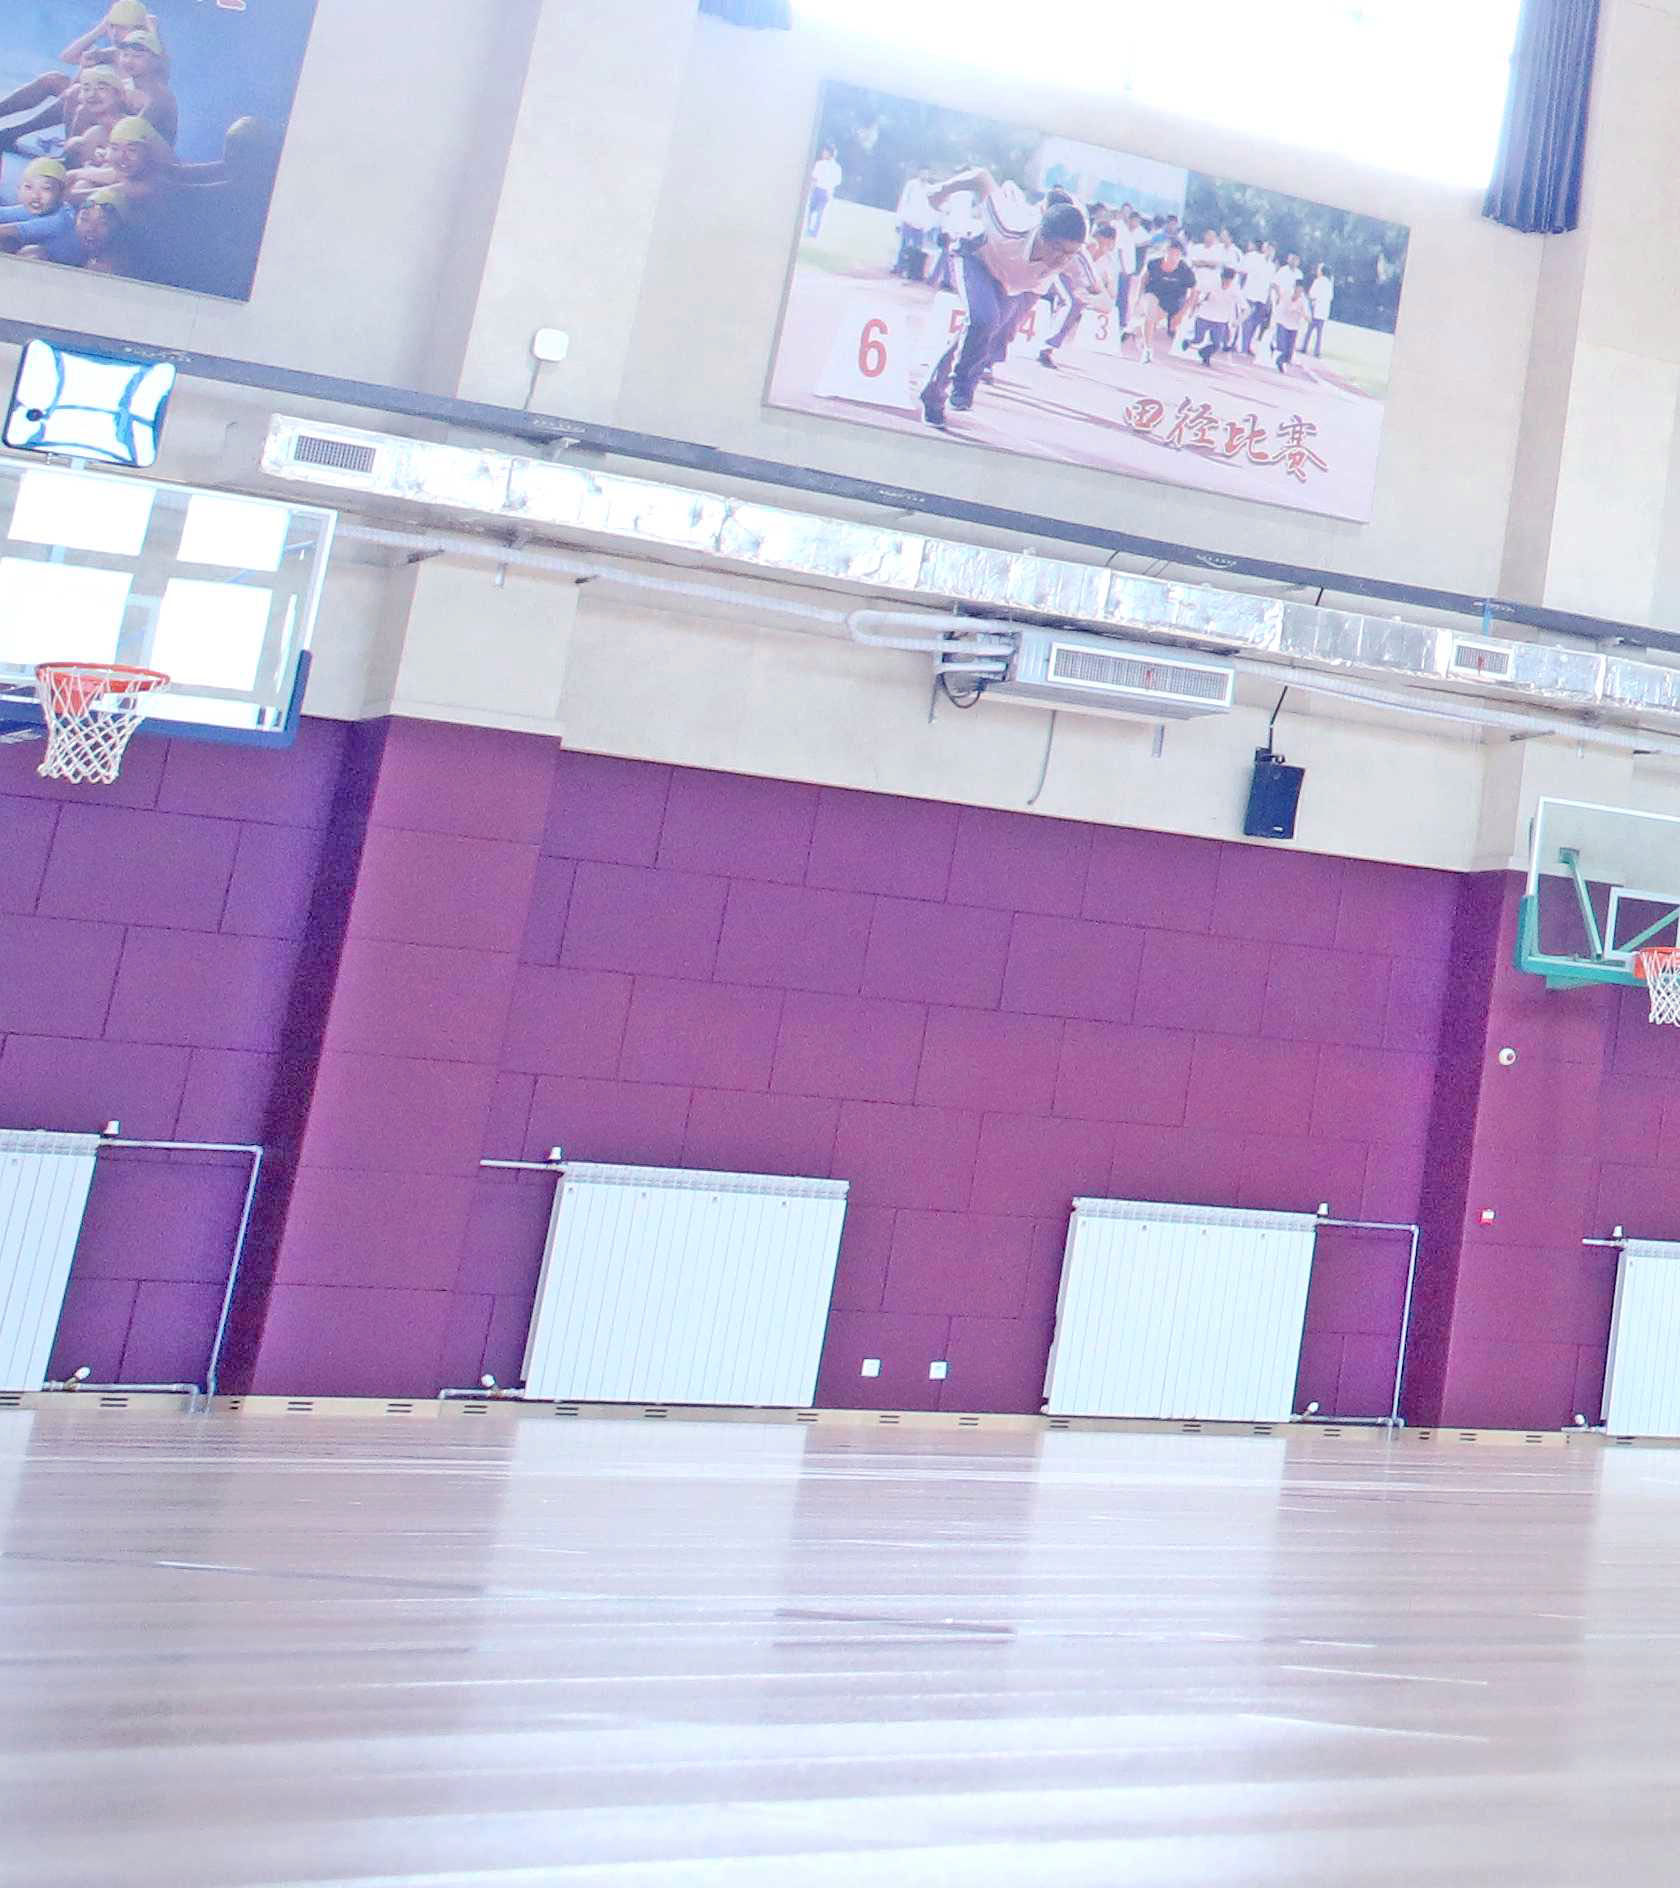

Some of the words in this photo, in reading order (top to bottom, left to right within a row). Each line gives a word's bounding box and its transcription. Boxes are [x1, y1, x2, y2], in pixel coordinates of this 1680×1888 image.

[857, 318, 889, 378] 6
[1095, 313, 1110, 341] 3
[1121, 395, 1330, 484] 田径比赛
